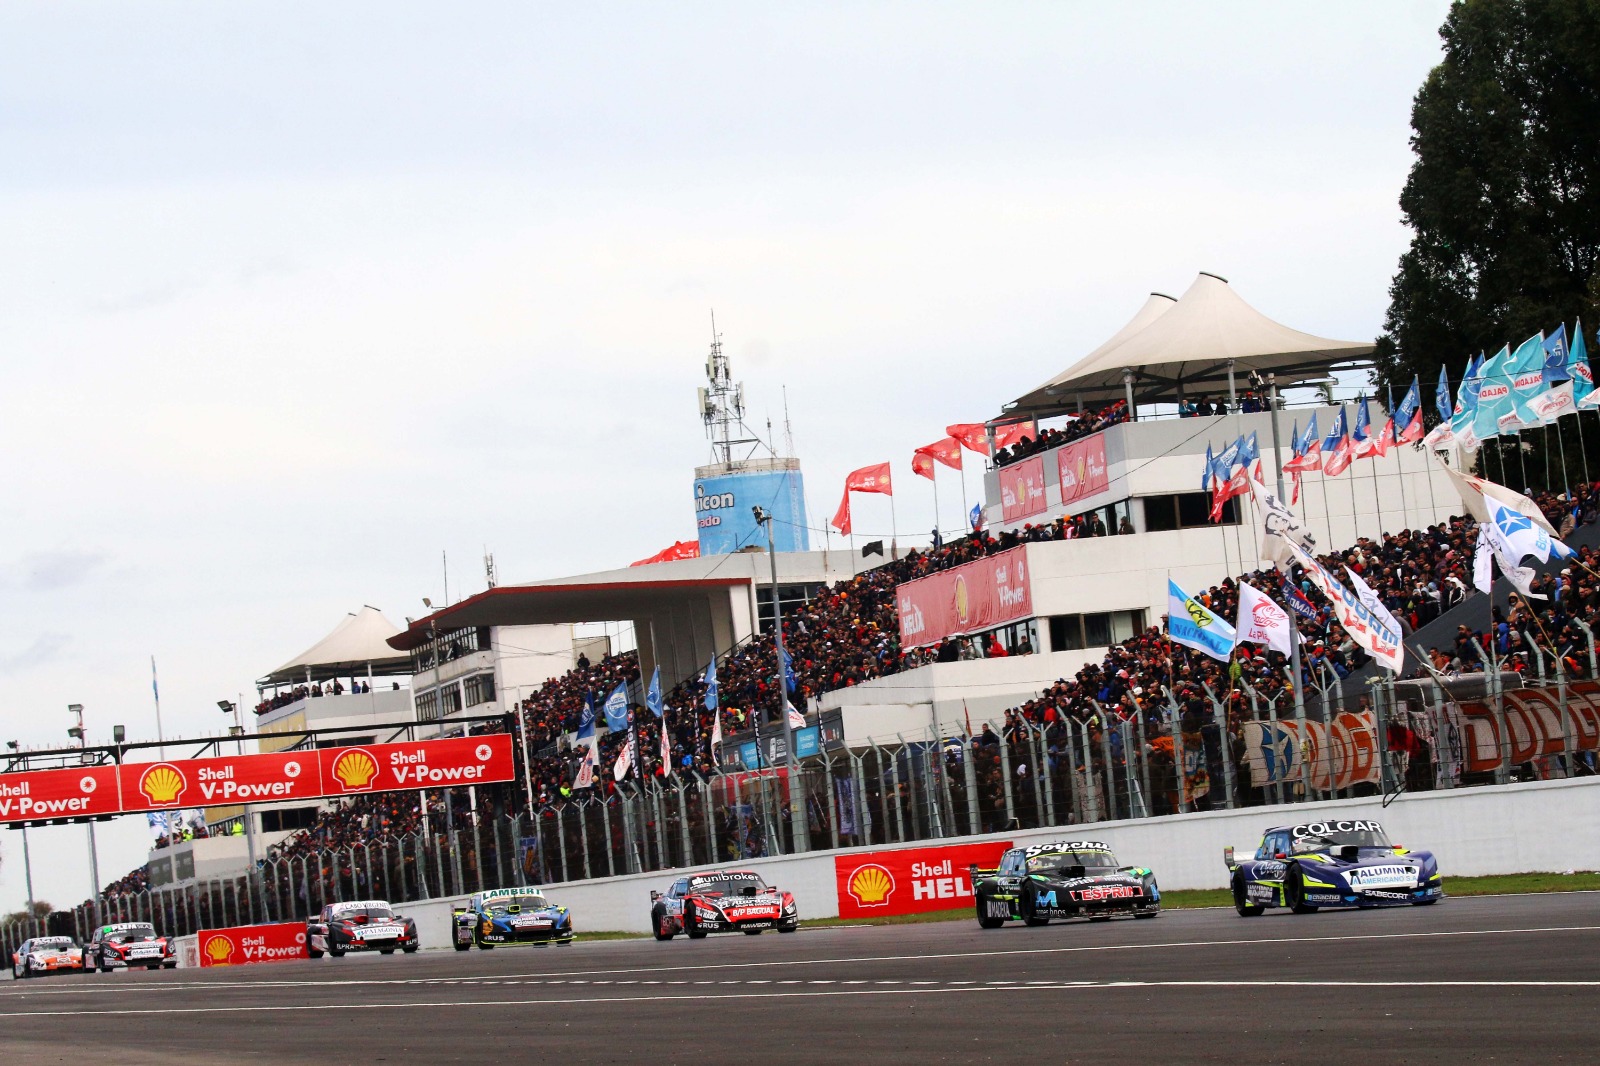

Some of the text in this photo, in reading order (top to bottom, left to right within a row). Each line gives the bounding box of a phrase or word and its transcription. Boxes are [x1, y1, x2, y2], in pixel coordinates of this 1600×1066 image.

[390, 749, 426, 765] Shell
[198, 765, 234, 780] Shell
[391, 764, 486, 784] V-Power
[0, 781, 30, 797] hell
[199, 781, 295, 800] V-Power
[0, 796, 91, 816] V-Power
[1292, 820, 1383, 838] COLCAR
[911, 859, 953, 878] Shell
[703, 872, 760, 884] unibroker
[482, 887, 540, 901] LAMBERT
[242, 936, 265, 947] Shell
[242, 945, 303, 959] V-Power
